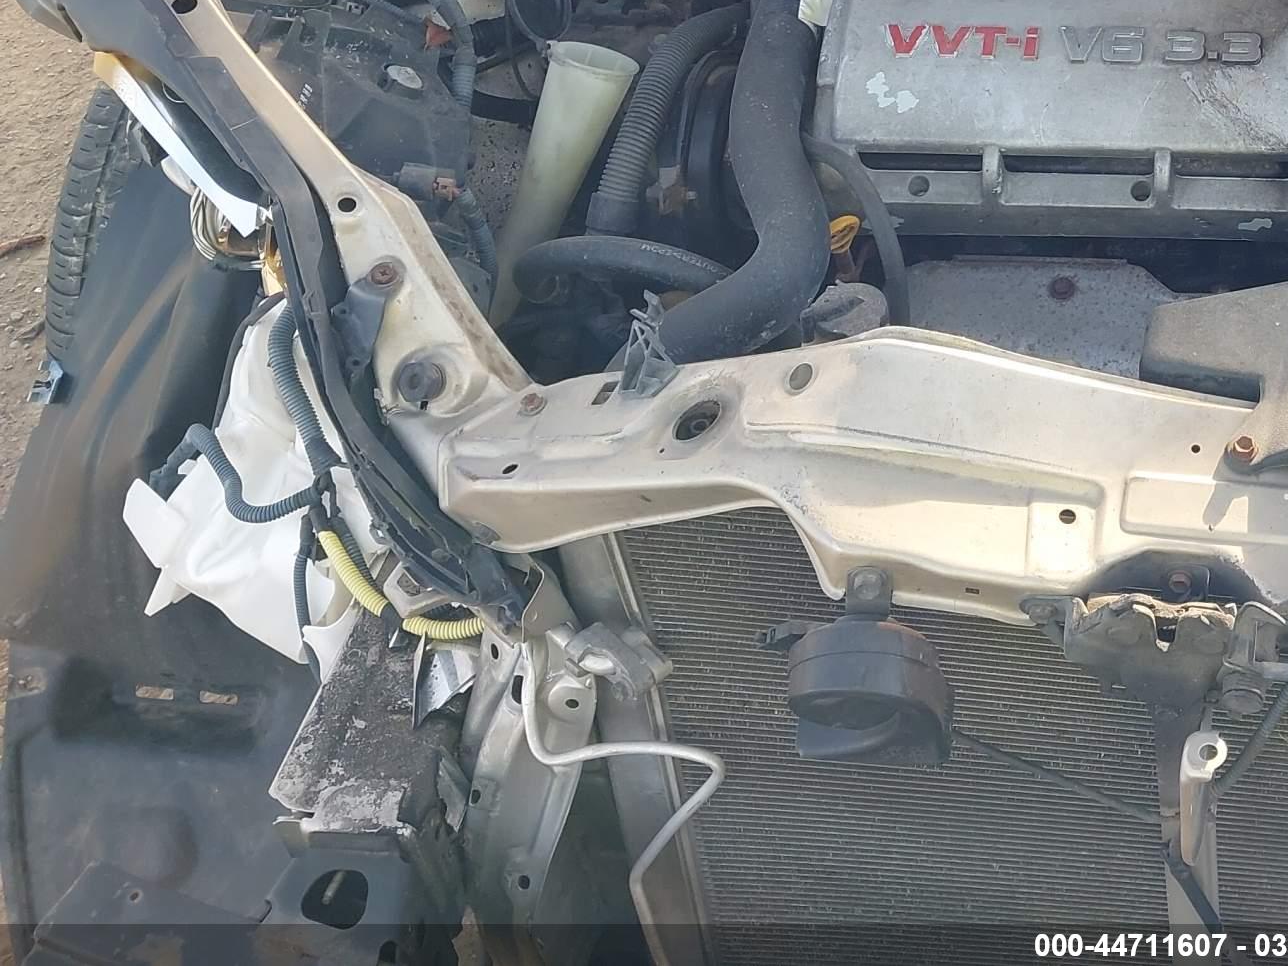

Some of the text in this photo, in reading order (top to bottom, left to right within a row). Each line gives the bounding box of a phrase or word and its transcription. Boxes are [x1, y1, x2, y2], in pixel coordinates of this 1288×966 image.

[884, 24, 1264, 65] VVT-i V6 3.3
